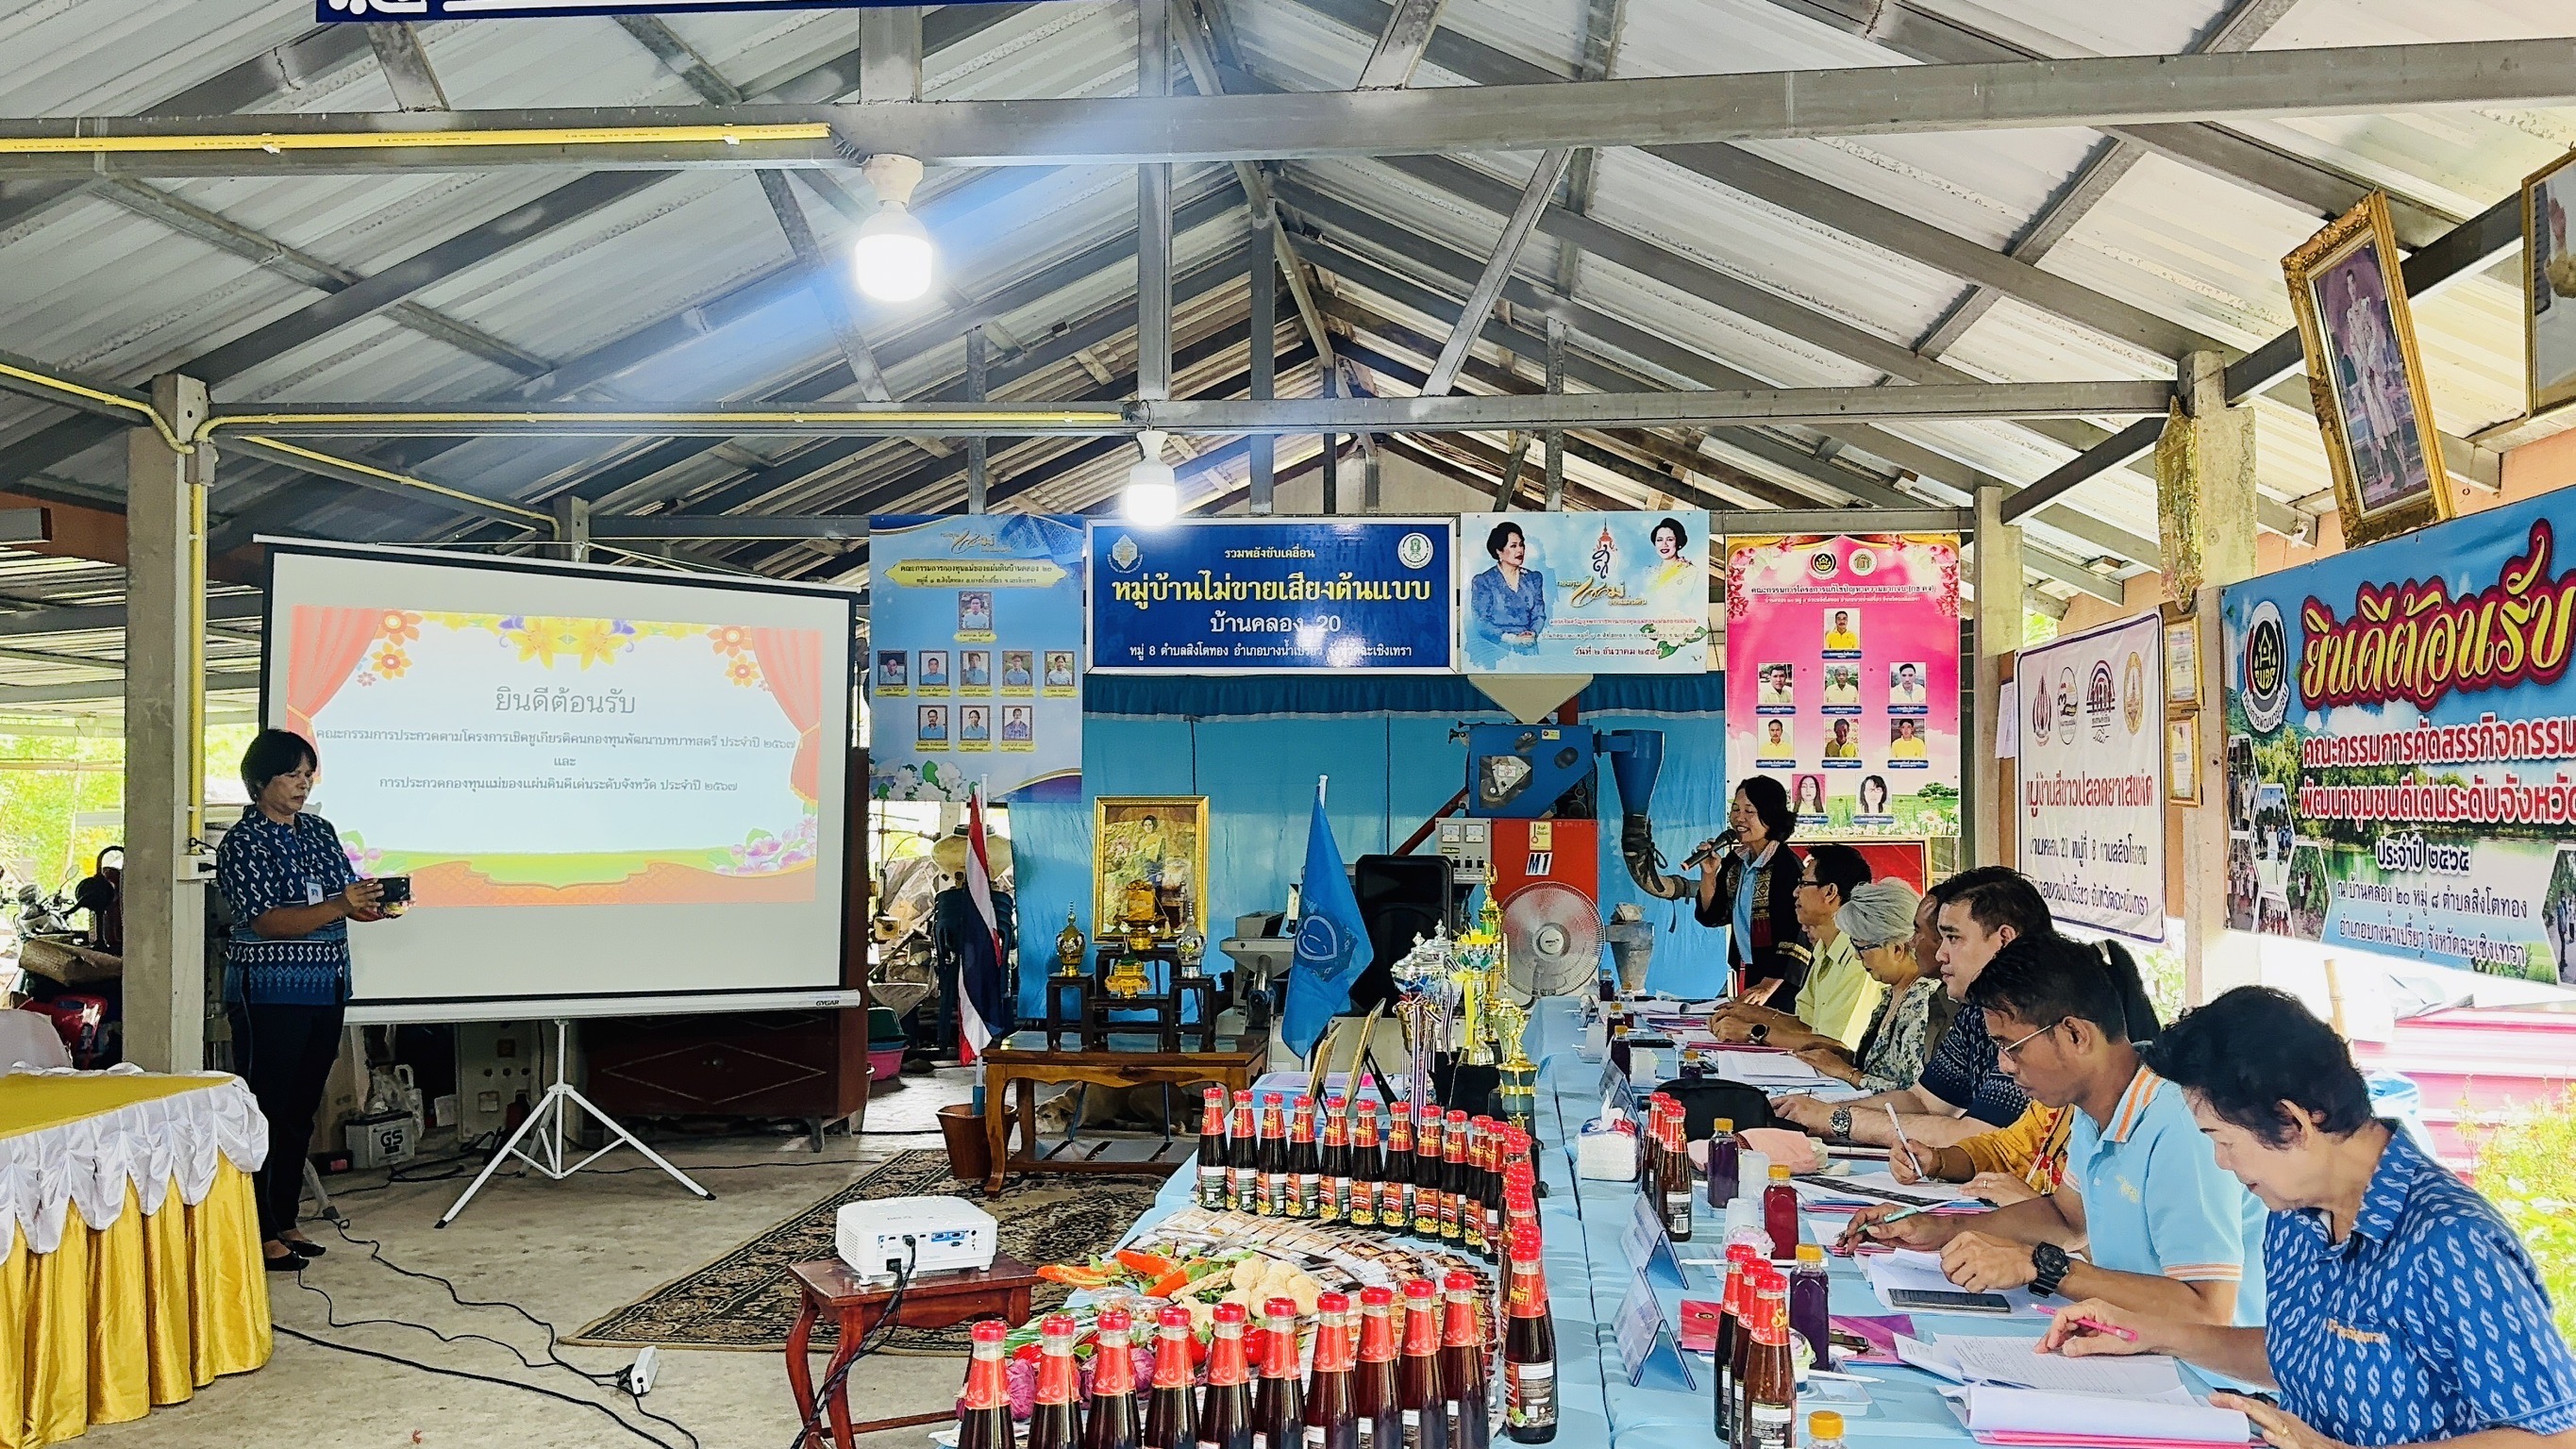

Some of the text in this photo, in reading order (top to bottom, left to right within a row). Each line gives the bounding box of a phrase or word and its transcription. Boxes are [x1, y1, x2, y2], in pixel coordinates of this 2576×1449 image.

[1225, 546, 1315, 559] รวมพลังขับเคลื่อน
[1111, 570, 1430, 610] หมู่บ้านไม่ขายเสียงต้นแบบ
[1211, 610, 1342, 632] บ้านคลอง 20
[2302, 535, 2576, 699] ยินดีต้อนรับ
[1129, 643, 1145, 660] หมู่
[1148, 645, 1156, 656] 8
[1161, 641, 1229, 657] ตำบลสิงโตทอง
[1574, 644, 1592, 656] วันที่
[495, 685, 636, 714] ยินดีต้อนรับ
[720, 736, 761, 748] ประจำปี
[762, 739, 796, 749] ๒๕๖๗
[554, 757, 577, 767] และ
[379, 775, 738, 793] การประกวดกองทุนแม่ของแผ่นดินดีเด่นระดับจังหวัด ประจำปี ๒๕๖๗
[2377, 835, 2424, 869] ประจำปี
[1527, 853, 1550, 874] M1
[2337, 881, 2346, 896] ณ
[2350, 873, 2392, 903] บ้านคลอง
[2395, 889, 2410, 906] ๒๐
[2414, 882, 2428, 917] หมู่
[2443, 885, 2528, 919] ตำบลสิงโตทอง
[380, 1129, 404, 1148] GS
